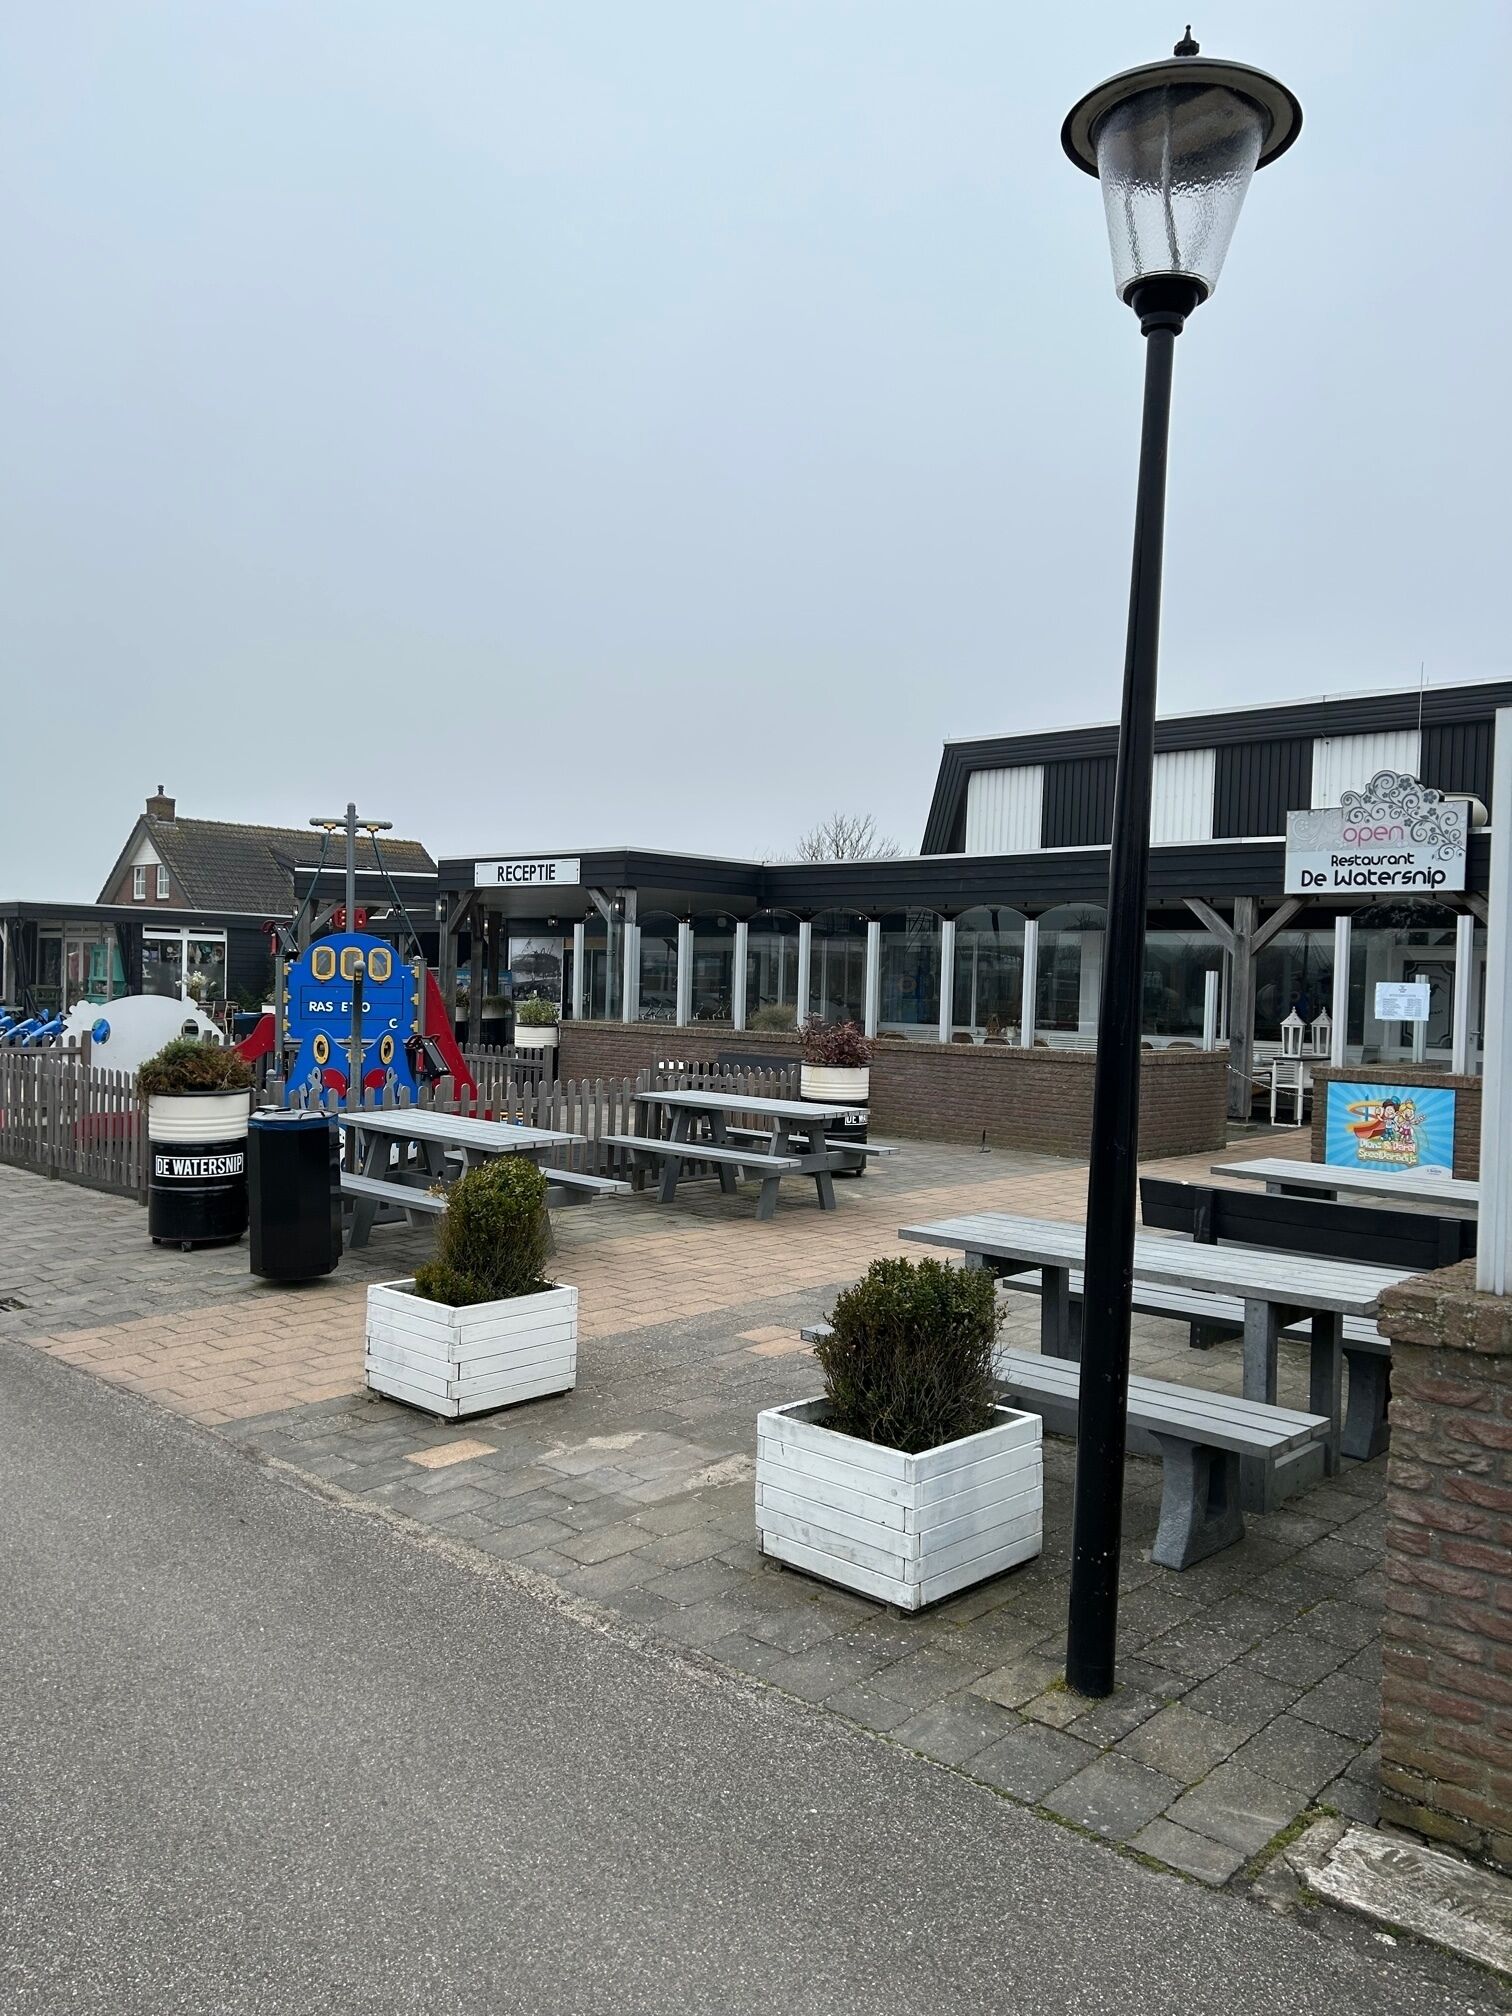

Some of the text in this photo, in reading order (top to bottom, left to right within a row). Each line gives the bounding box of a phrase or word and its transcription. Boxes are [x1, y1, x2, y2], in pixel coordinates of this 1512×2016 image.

[1343, 825, 1404, 847] open
[1331, 852, 1415, 867] Restaurant
[497, 863, 556, 882] RECEPTIE
[1301, 867, 1446, 889] De Watersnip
[157, 1155, 242, 1175] DE WATERSNIP
